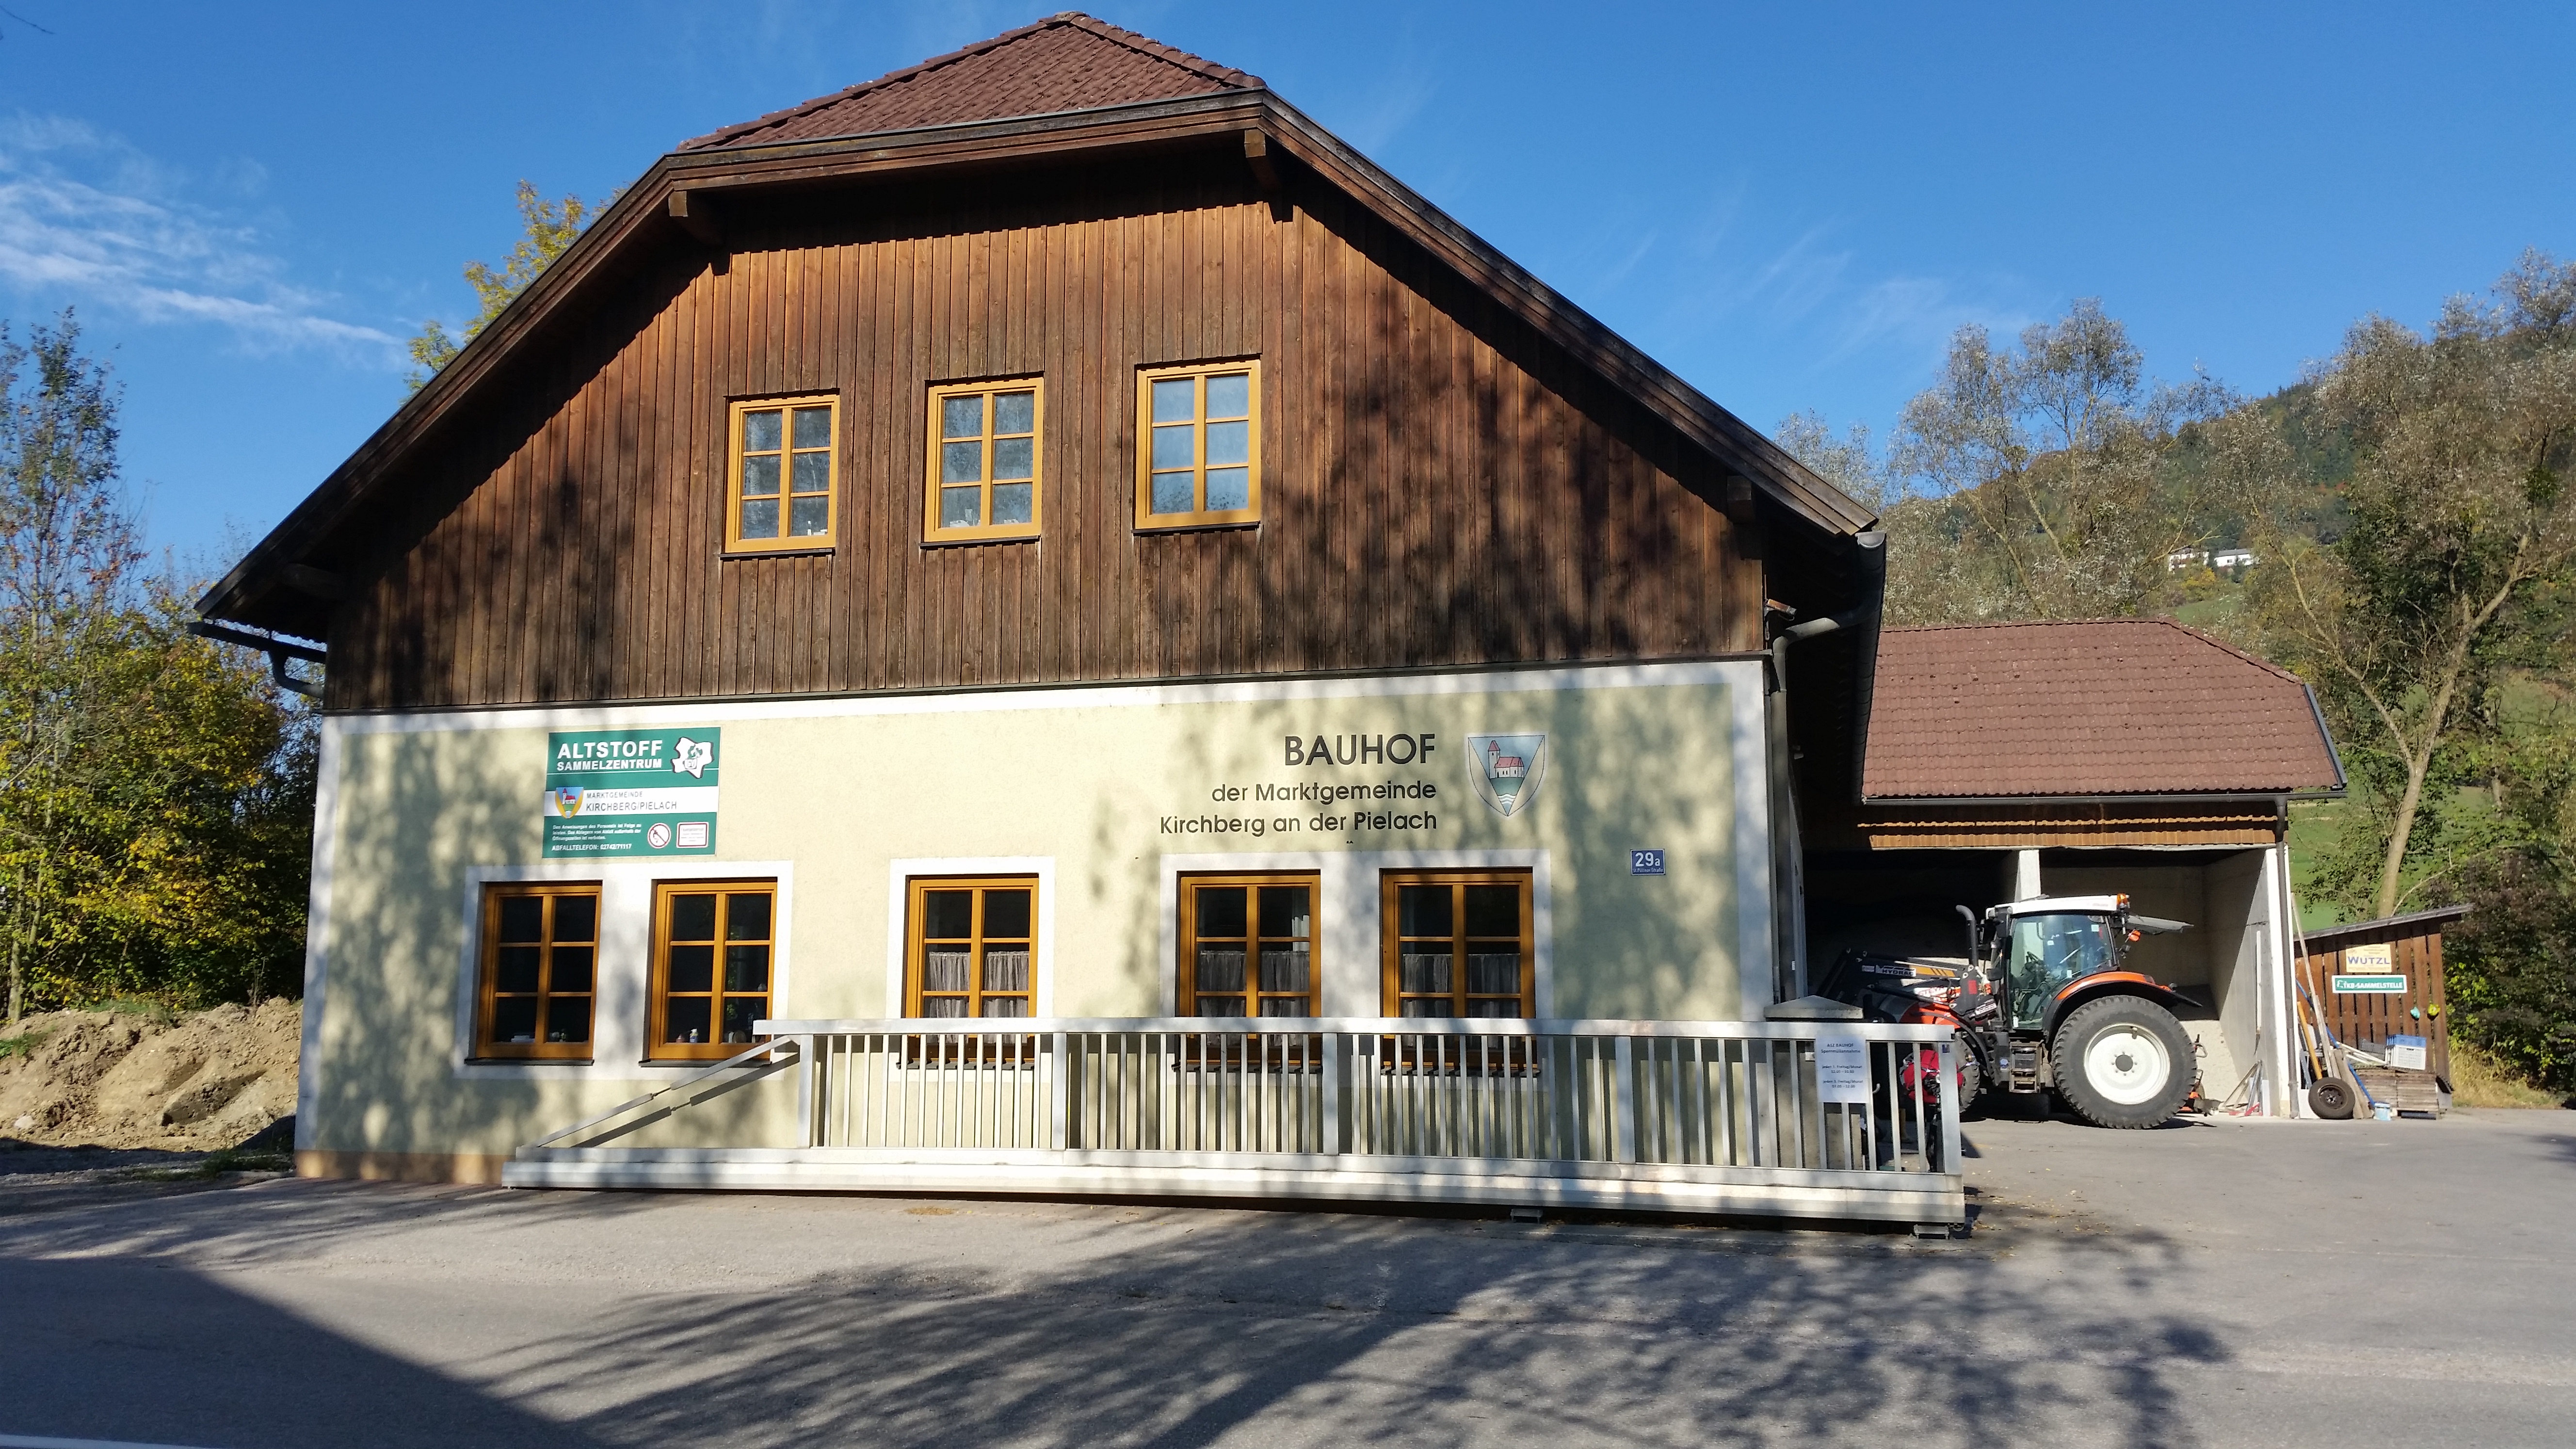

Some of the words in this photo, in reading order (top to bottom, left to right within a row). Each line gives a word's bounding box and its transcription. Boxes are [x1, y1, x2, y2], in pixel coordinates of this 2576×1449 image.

[557, 740, 663, 759] ALTSTOFF
[1284, 733, 1436, 767] BAUHOF
[557, 758, 662, 771] SAMMELZENTRUM
[1212, 783, 1248, 802] der
[1256, 780, 1437, 805] Marktgemeinde
[586, 801, 677, 811] KIRCHBERG/PIELACH
[1160, 815, 1265, 837] Kirchberg
[1272, 817, 1300, 832] an
[1309, 814, 1347, 832] der
[1353, 811, 1437, 831] Pielach
[1635, 852, 1660, 867] 29a
